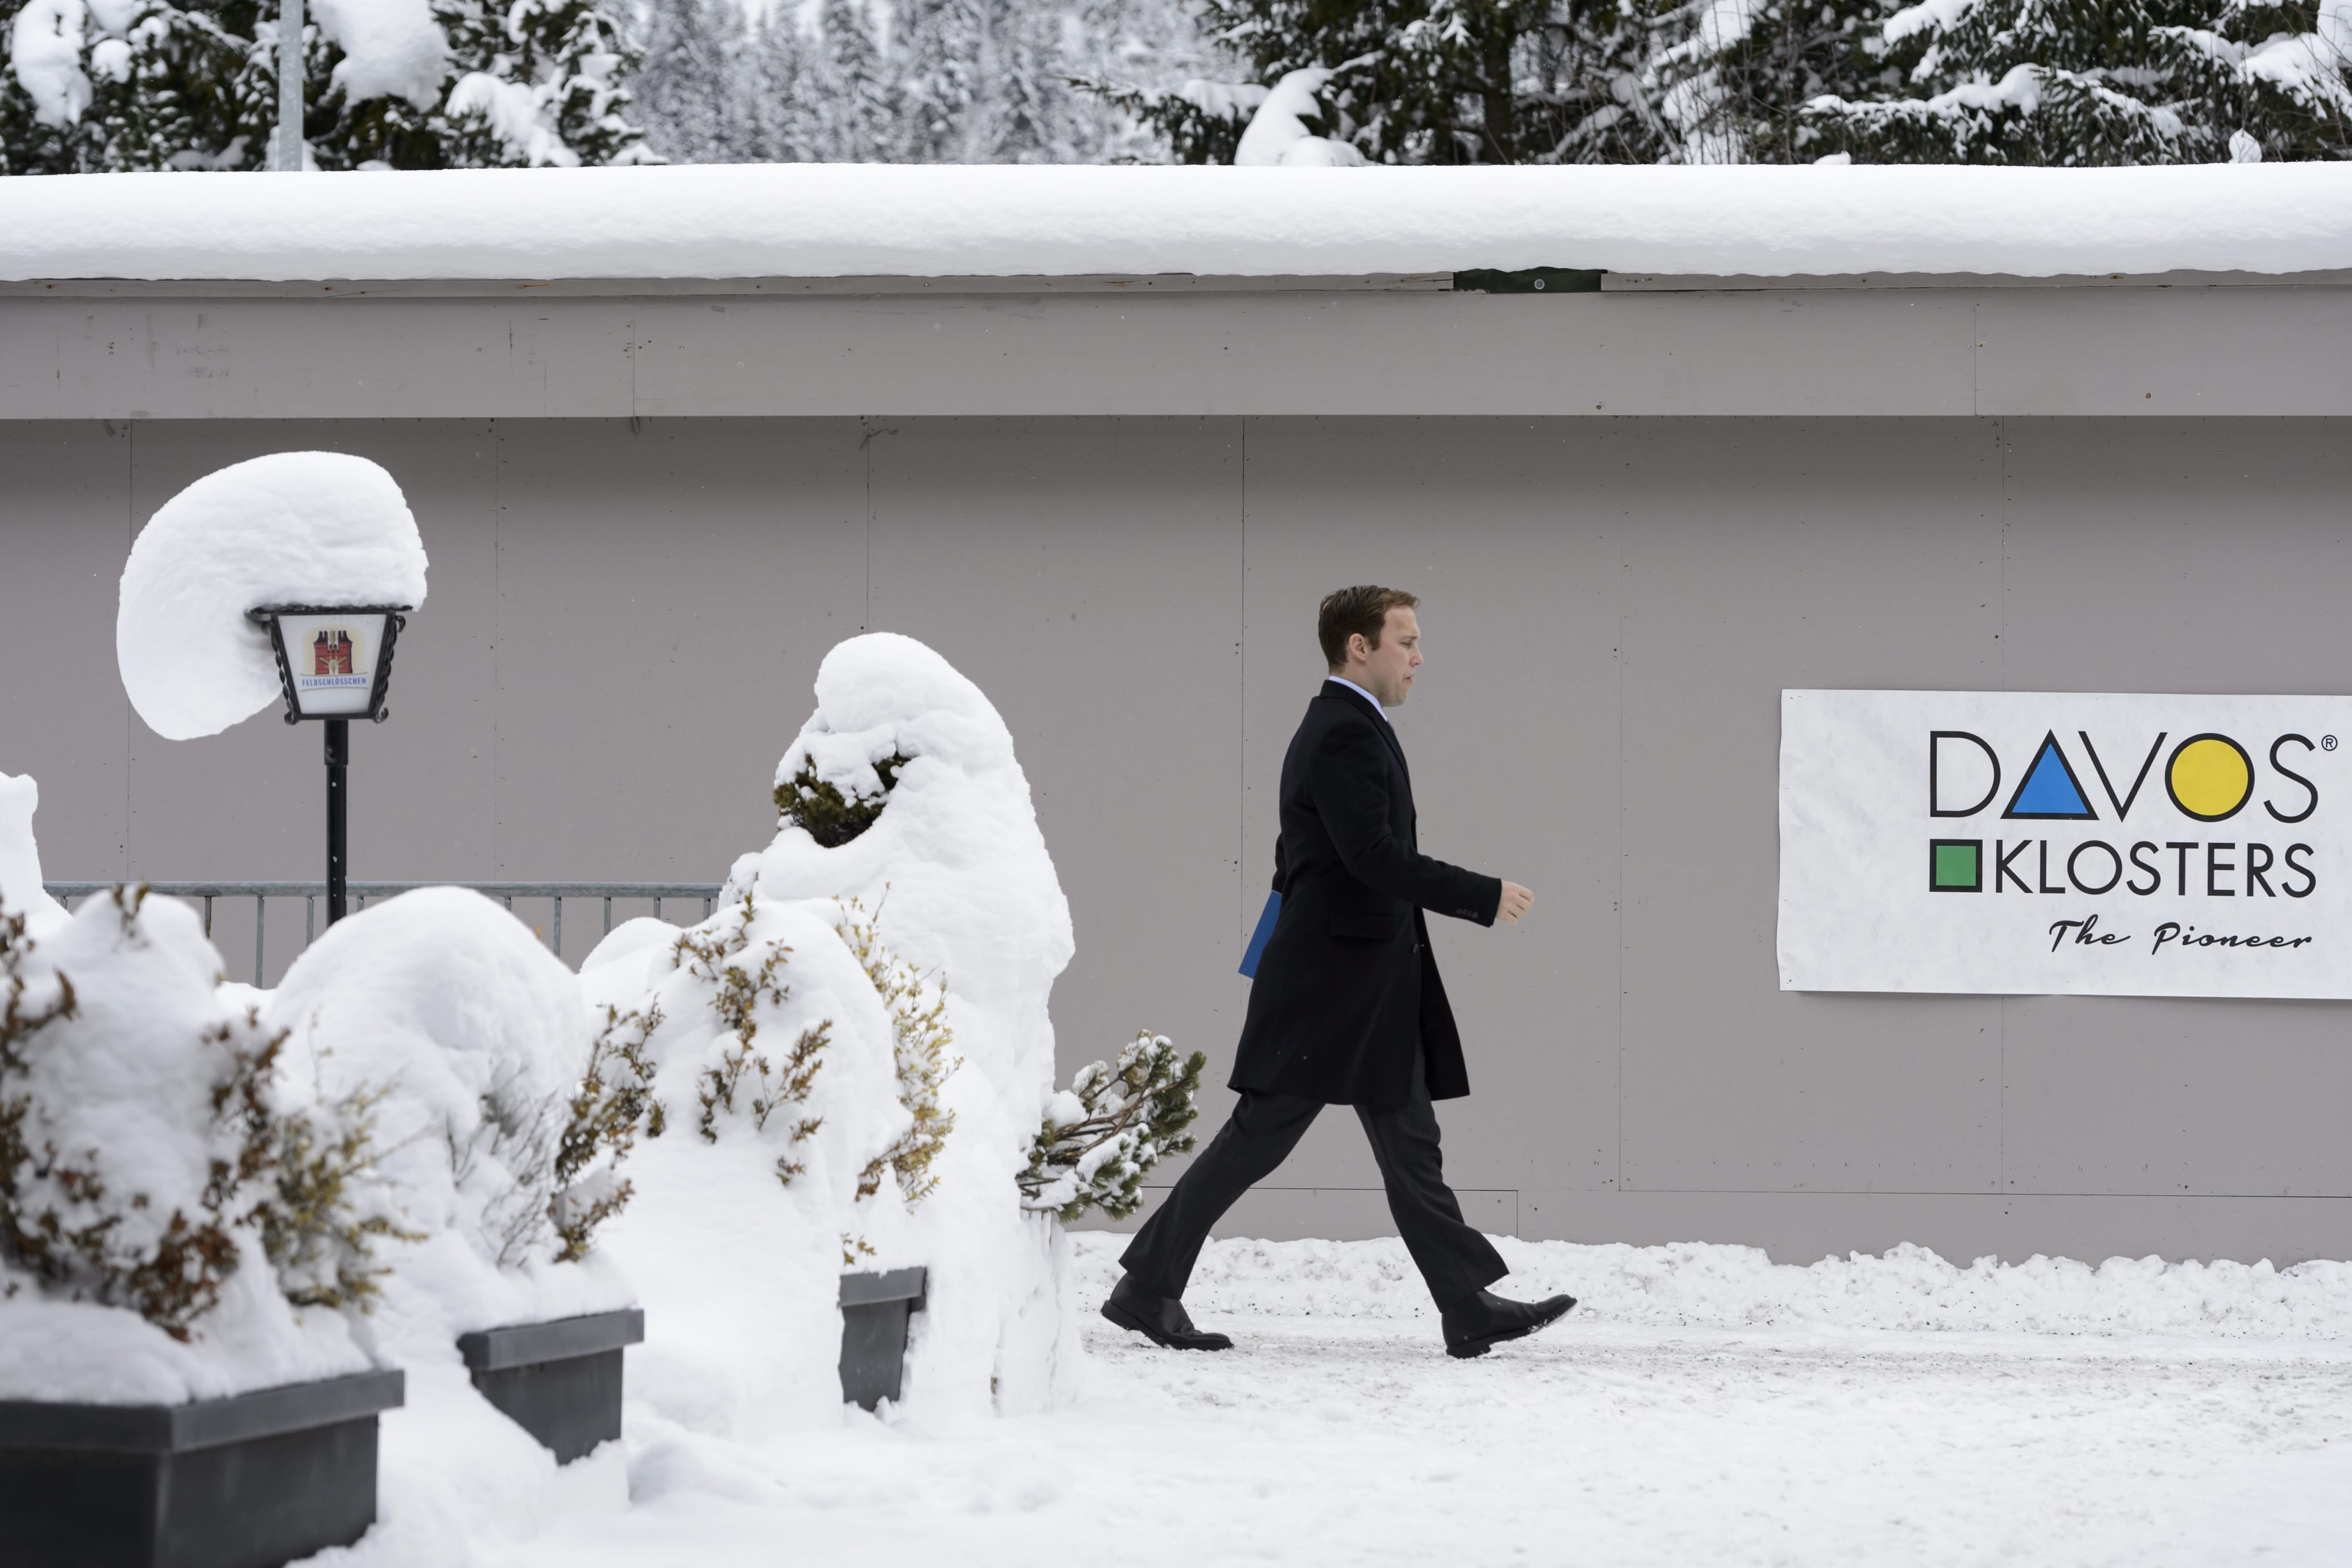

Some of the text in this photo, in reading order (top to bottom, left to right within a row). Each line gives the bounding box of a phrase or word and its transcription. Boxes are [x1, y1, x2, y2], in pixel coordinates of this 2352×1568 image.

[301, 677, 366, 687] FELDSCHLÖSSCHEN
[1995, 839, 2316, 898] KLOSTERS
[2048, 913, 2312, 955] The Pioneer
